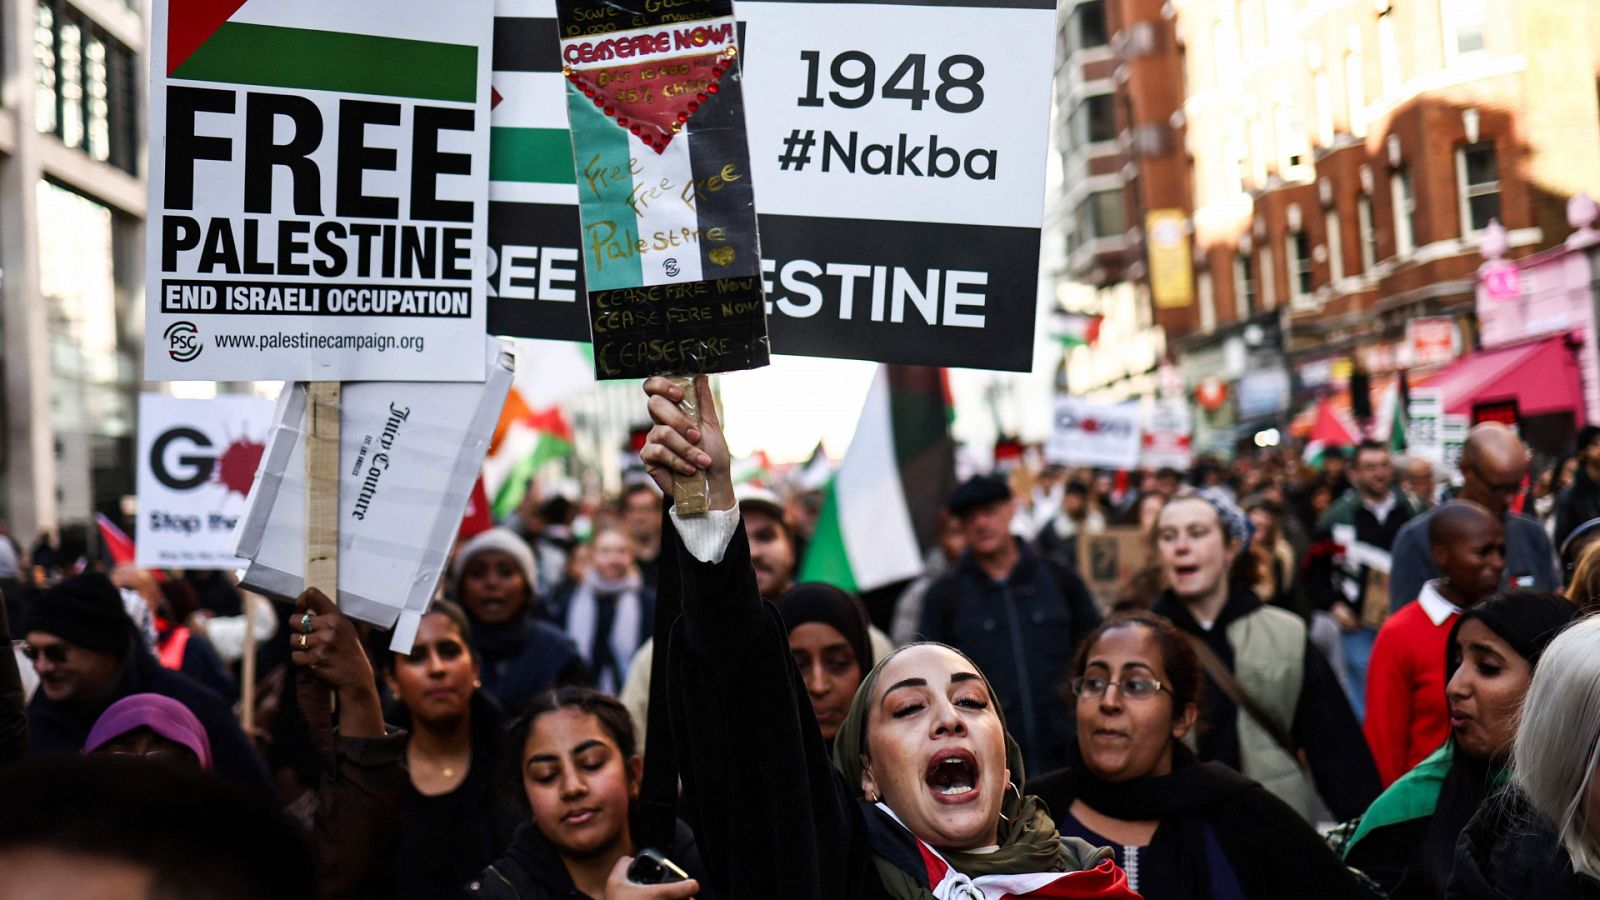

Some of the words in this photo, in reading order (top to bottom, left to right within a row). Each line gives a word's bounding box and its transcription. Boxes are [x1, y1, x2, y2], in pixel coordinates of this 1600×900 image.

[563, 32, 671, 65] CEASEFIRE
[674, 23, 734, 50] NOW!
[797, 50, 985, 113] 1948
[163, 85, 475, 222] FREE
[584, 154, 643, 200] Free
[778, 129, 998, 180] #Nakba
[625, 177, 675, 218] Free
[681, 163, 742, 212] Free
[161, 215, 472, 280] PALESTINE
[166, 285, 216, 310] END
[225, 286, 319, 312] ISRAELI
[327, 289, 468, 315] OCCUPATION
[171, 334, 196, 350] PSC
[215, 332, 424, 353] www.palestinecampaign.org
[376, 401, 411, 451] Juicy
[352, 452, 389, 521] Couture
[150, 511, 200, 536] Stop
